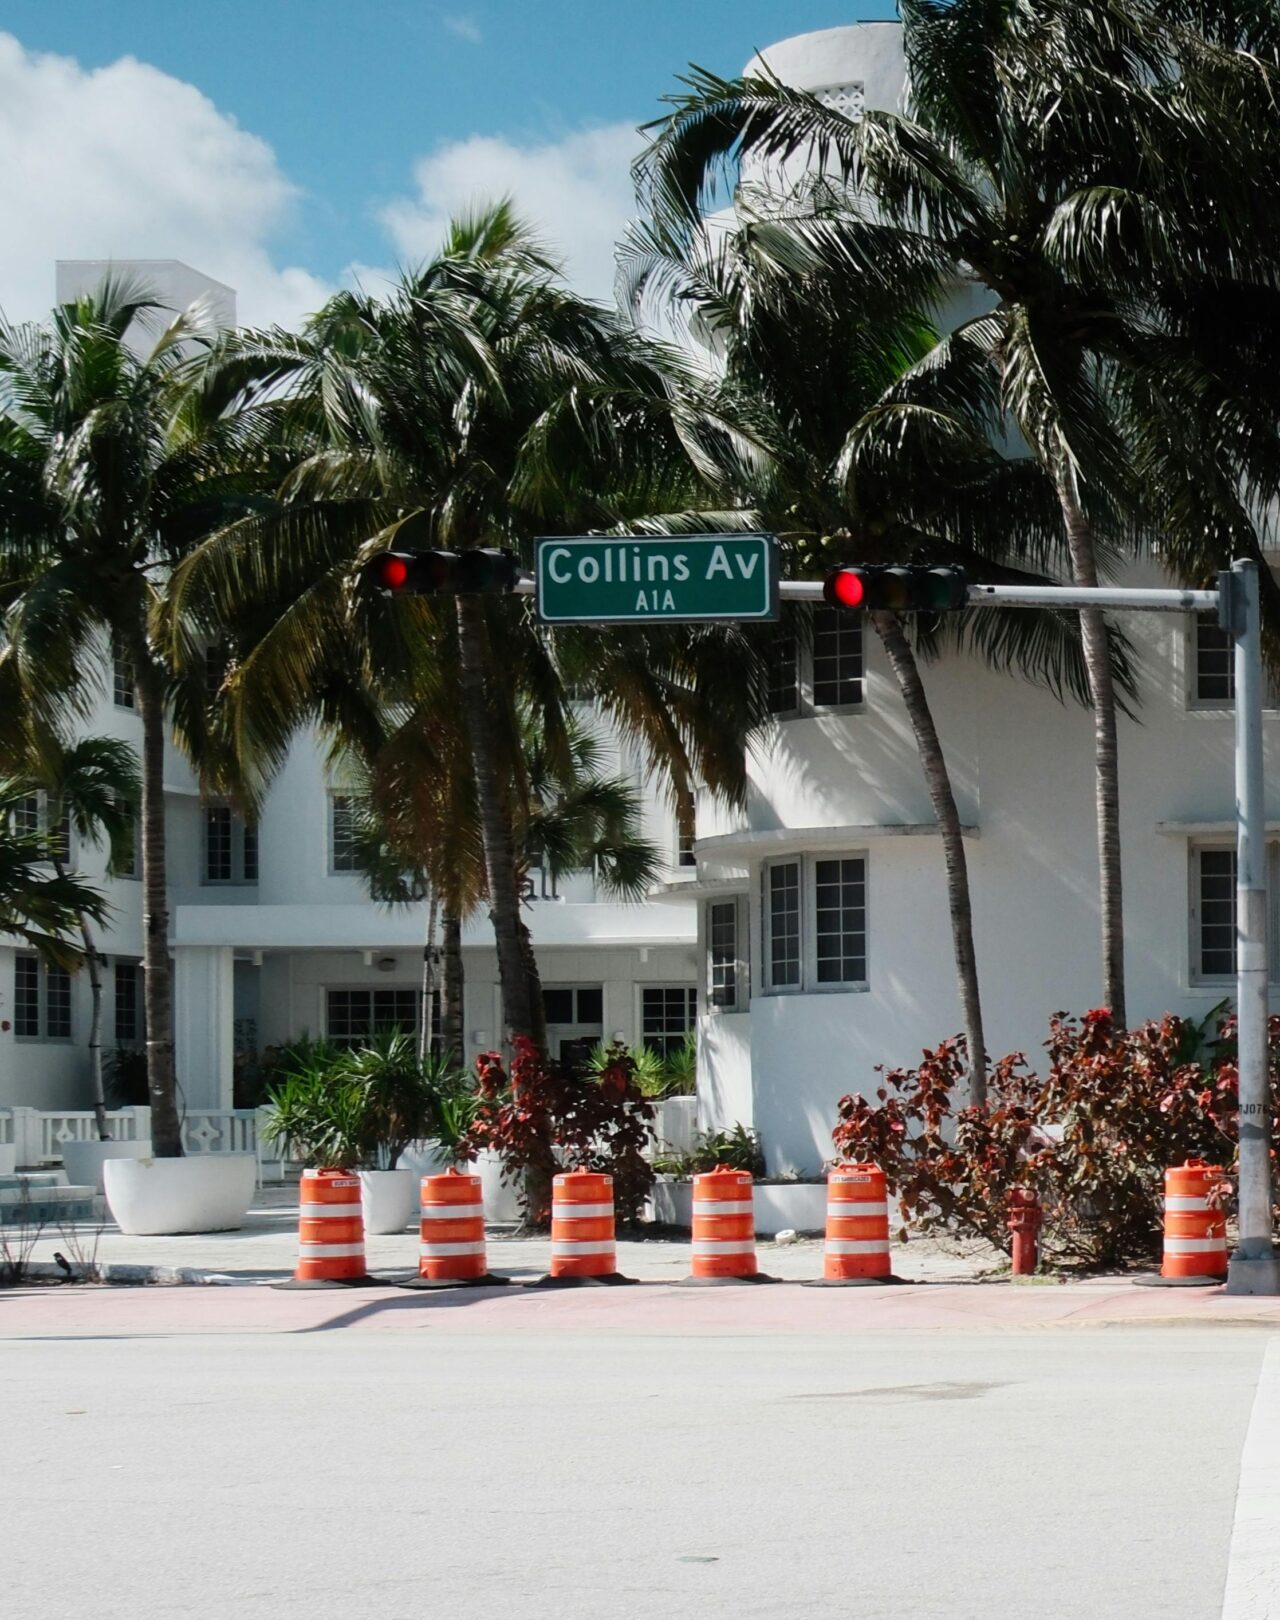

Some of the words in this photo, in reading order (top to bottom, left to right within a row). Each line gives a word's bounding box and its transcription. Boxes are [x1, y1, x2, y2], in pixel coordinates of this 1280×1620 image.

[548, 546, 690, 584] Collins
[705, 545, 759, 580] Av
[635, 589, 676, 611] A1A
